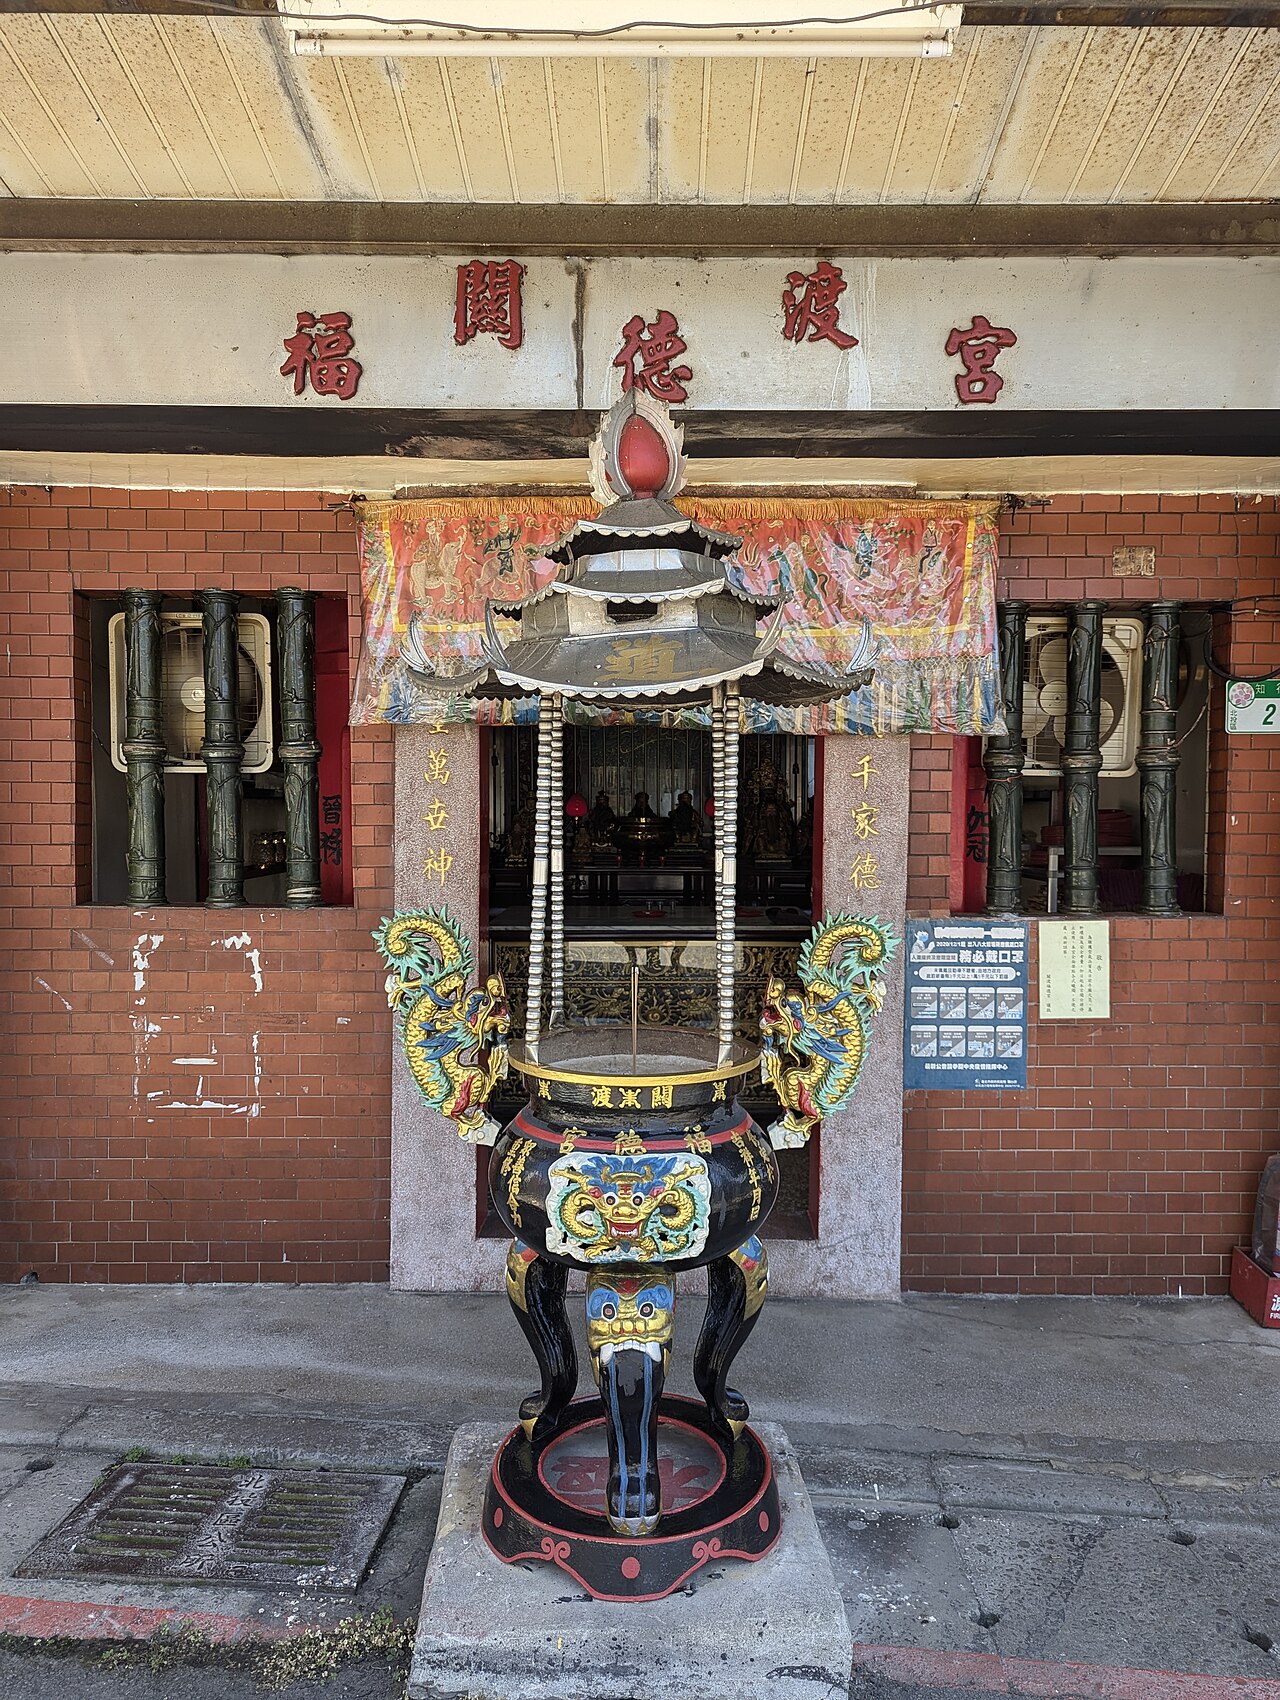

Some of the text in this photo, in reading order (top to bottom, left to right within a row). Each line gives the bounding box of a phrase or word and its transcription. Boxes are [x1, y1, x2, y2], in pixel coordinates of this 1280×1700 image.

[850, 732, 882, 890] 千家德
[958, 949, 1024, 964] 務必戴口罩
